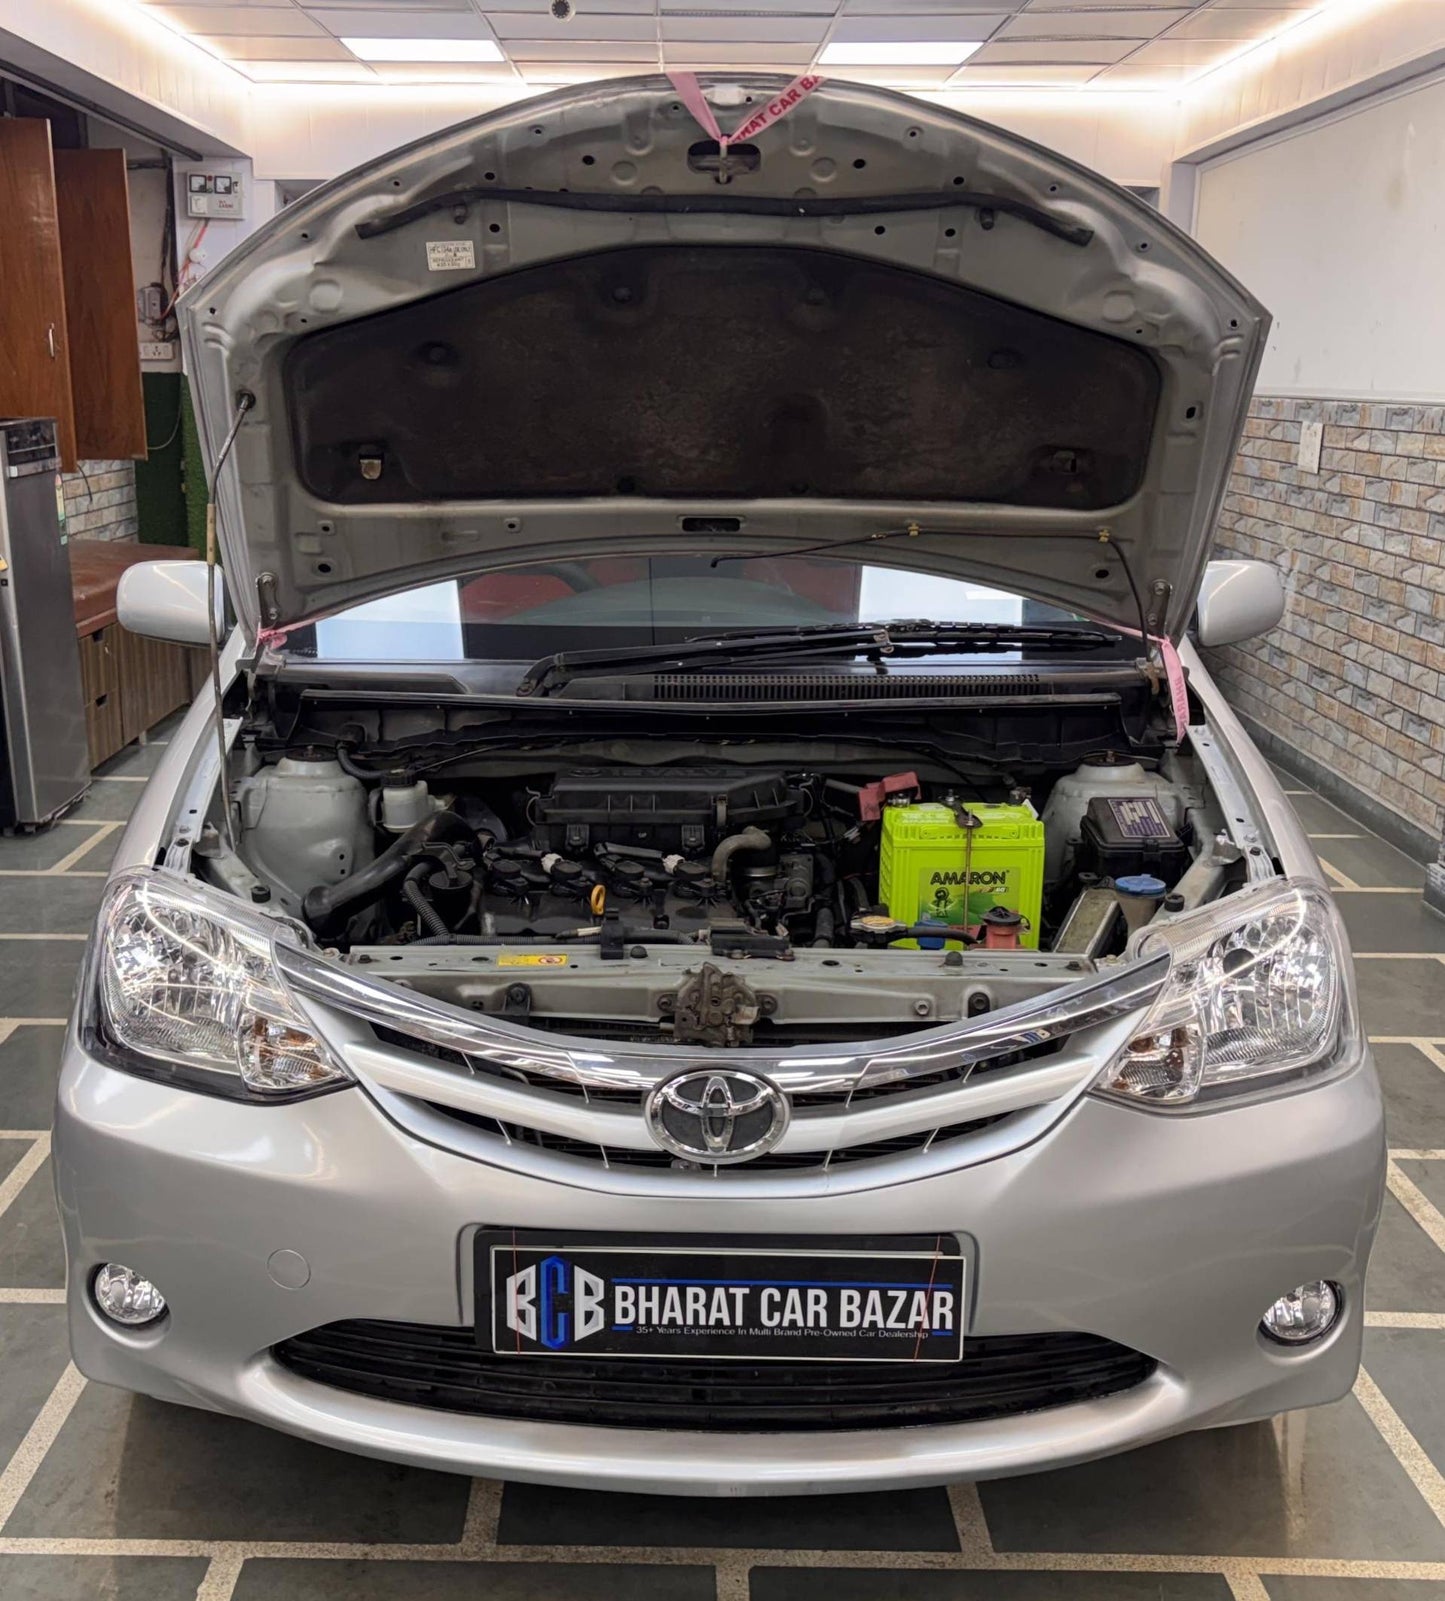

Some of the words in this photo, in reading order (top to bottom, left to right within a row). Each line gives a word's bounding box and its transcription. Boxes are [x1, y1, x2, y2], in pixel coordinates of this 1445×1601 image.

[769, 89, 802, 116] CAR
[930, 871, 1006, 885] AMARON
[506, 1256, 605, 1349] BCB
[614, 1285, 750, 1326] BHARAT
[760, 1287, 828, 1327] CAR
[839, 1288, 954, 1330] BAZAR
[636, 1326, 653, 1334] 35+
[656, 1326, 681, 1334] Years
[684, 1326, 735, 1336] Experience
[749, 1328, 771, 1336] Multi
[774, 1328, 802, 1336] Brand
[804, 1329, 857, 1337] Pre-Owned
[859, 1329, 876, 1337] Car
[878, 1330, 928, 1339] Dealership
